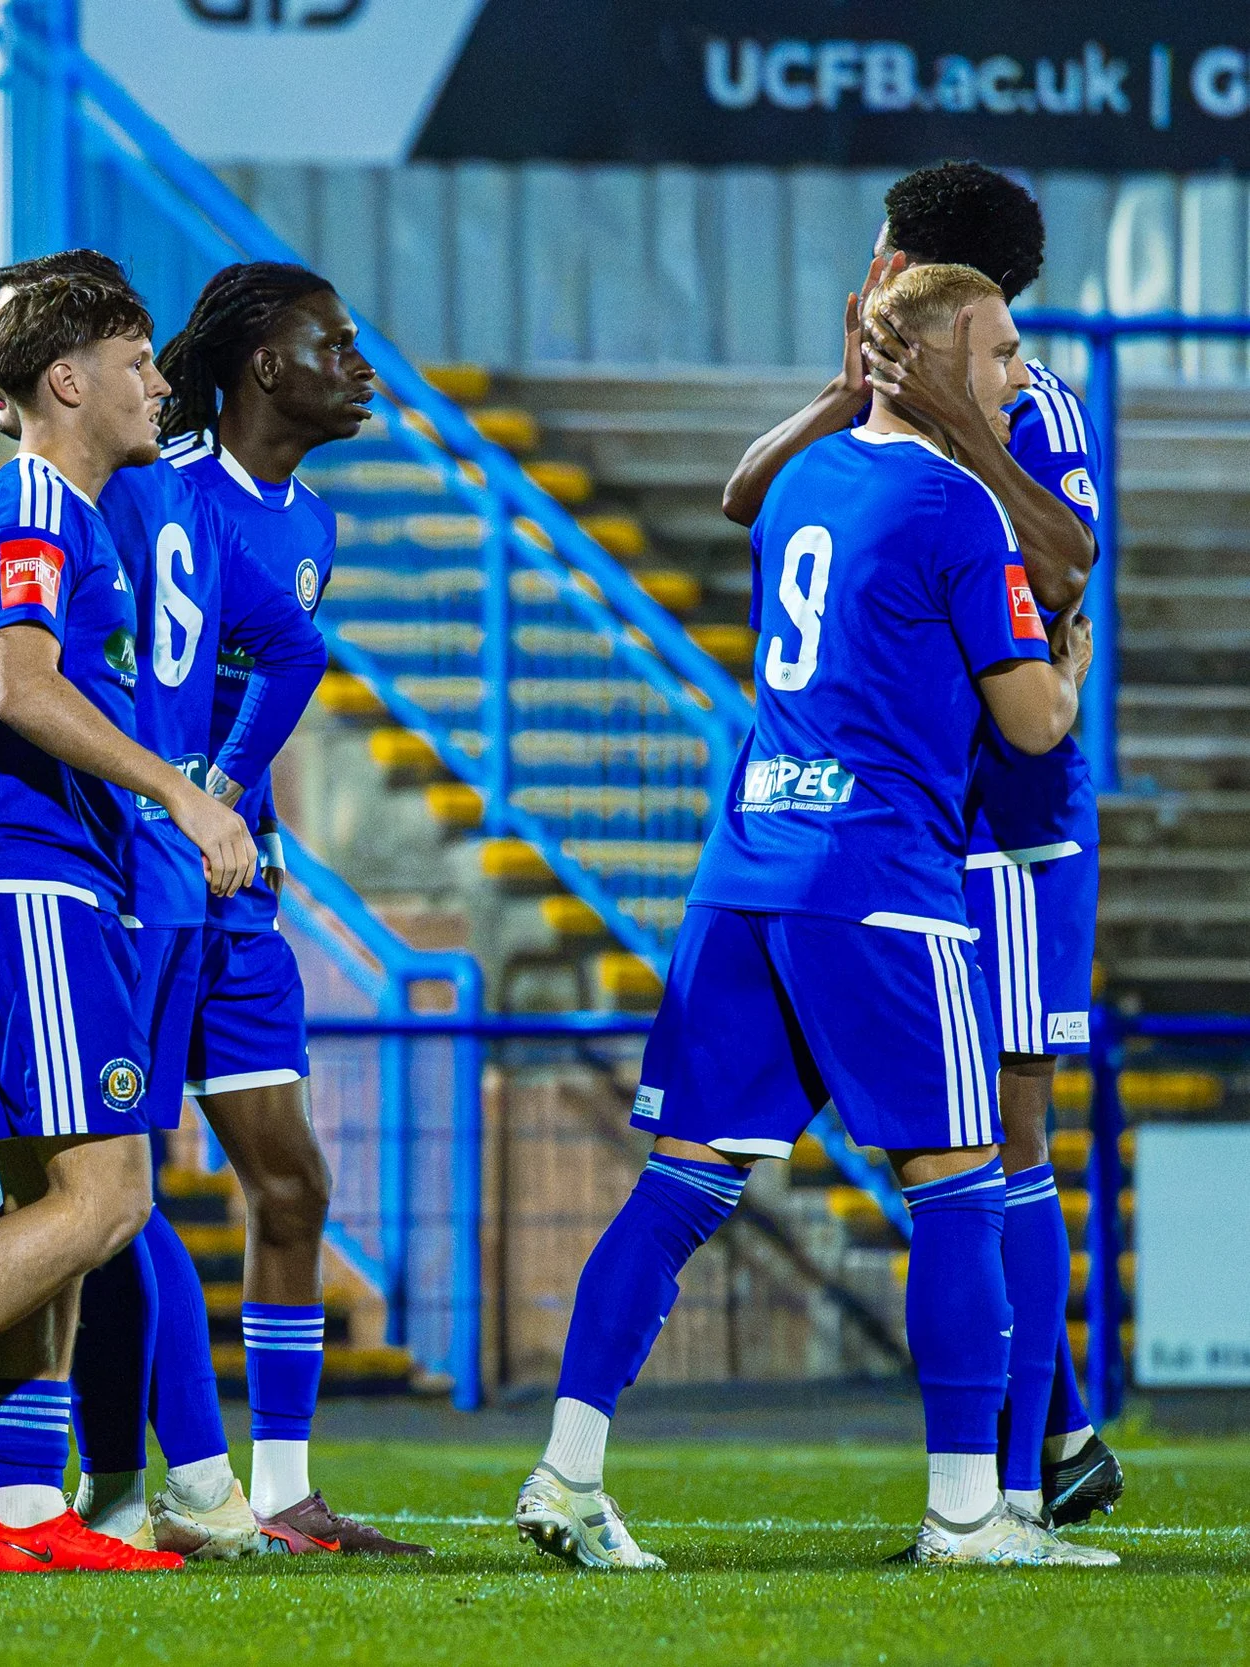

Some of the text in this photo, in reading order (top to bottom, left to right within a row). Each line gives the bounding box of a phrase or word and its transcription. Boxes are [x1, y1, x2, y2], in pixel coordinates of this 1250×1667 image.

[703, 37, 1131, 115] UCFB.ac.uk
[765, 525, 833, 691] 9
[217, 664, 251, 681] Electri
